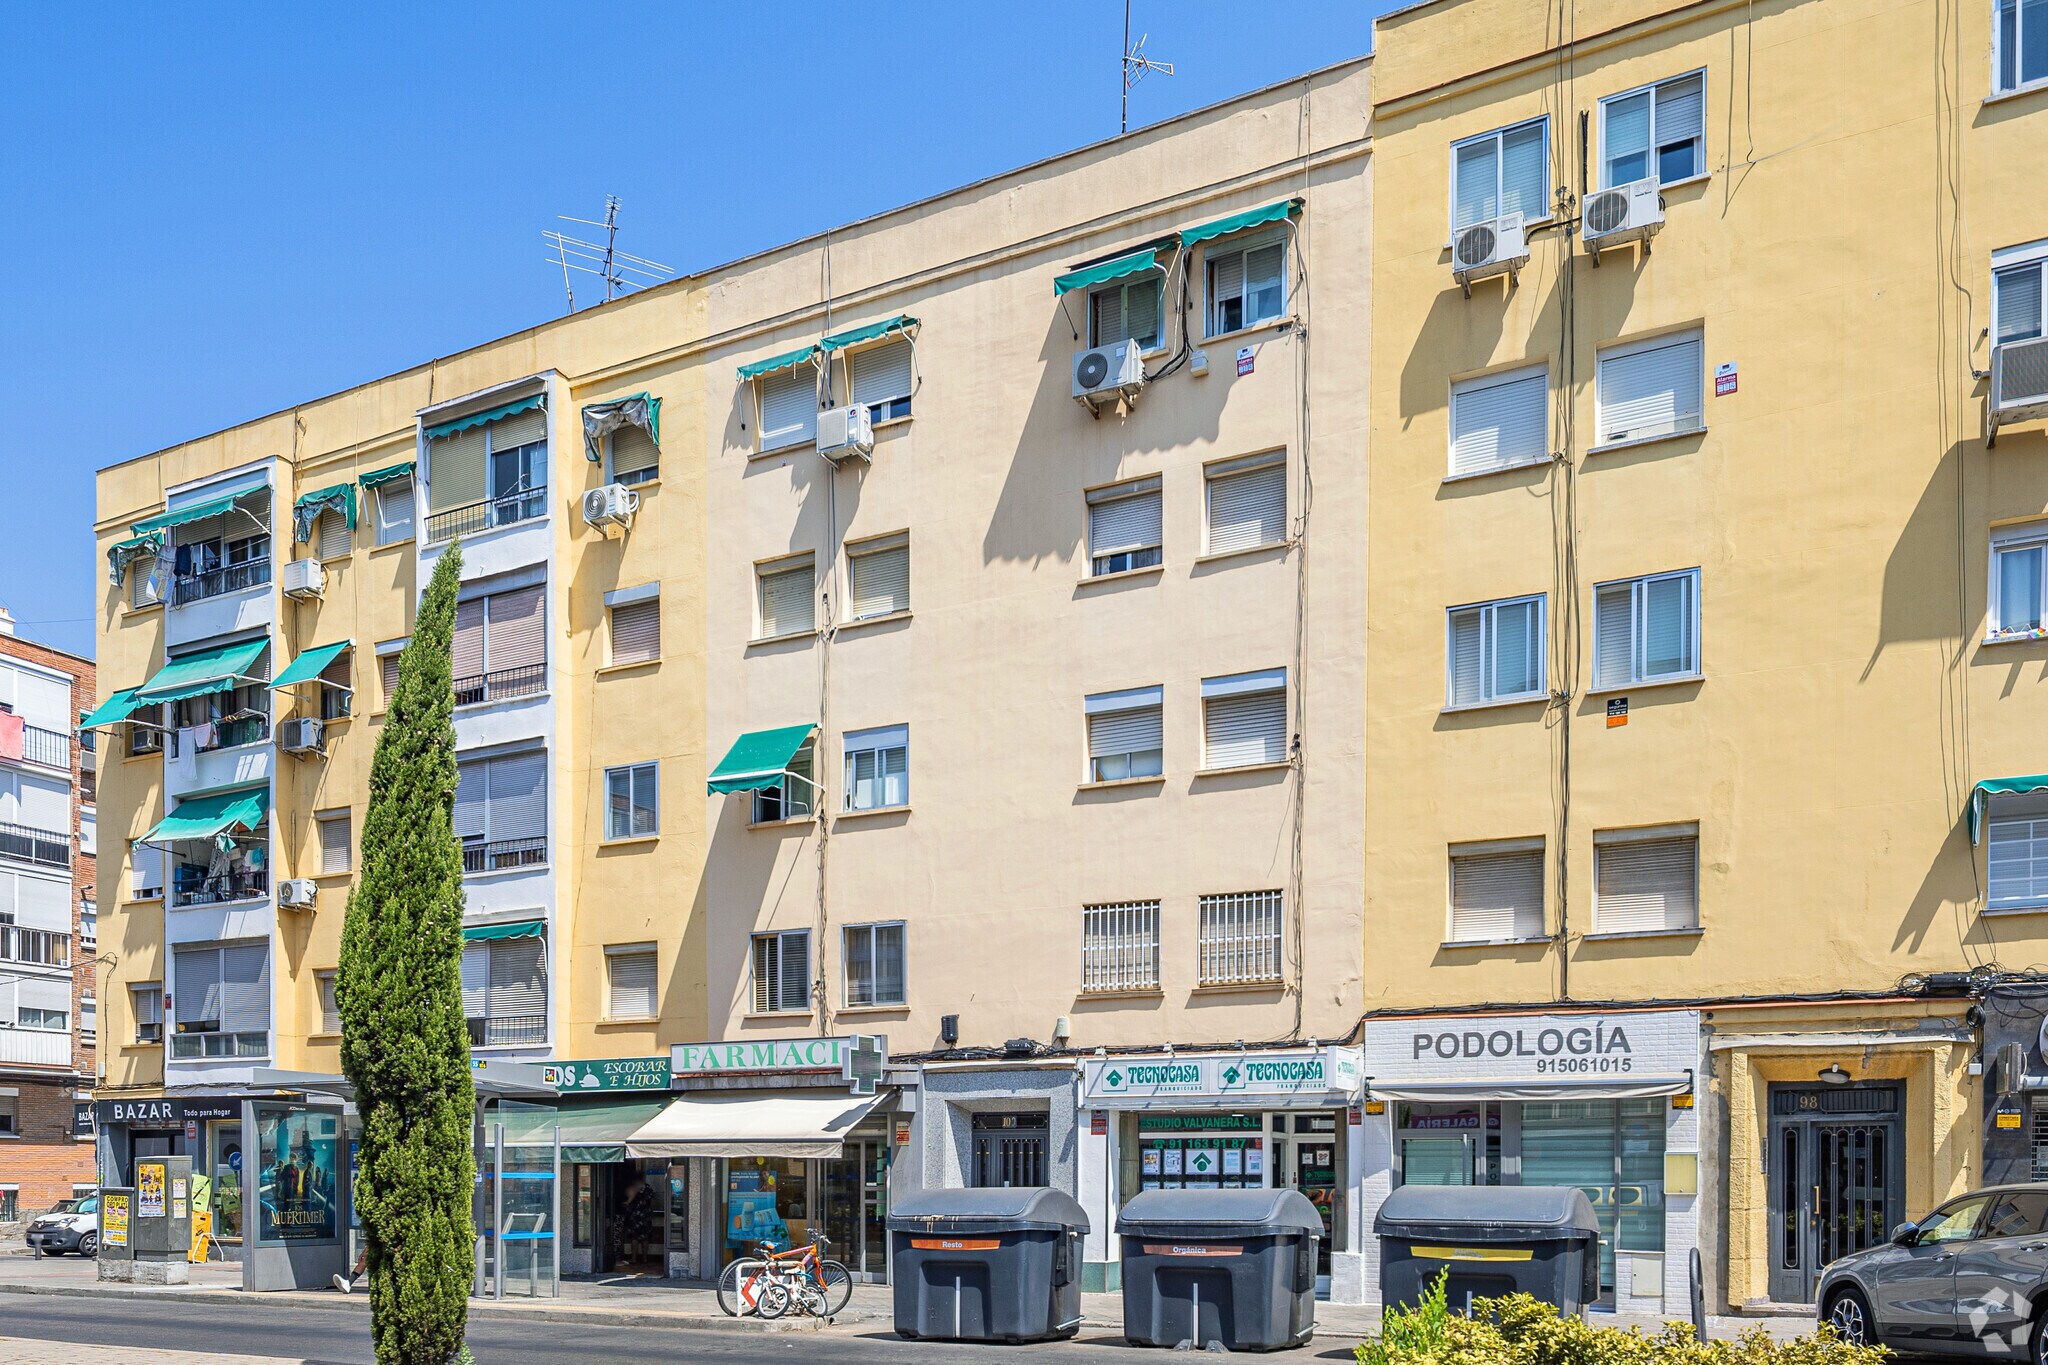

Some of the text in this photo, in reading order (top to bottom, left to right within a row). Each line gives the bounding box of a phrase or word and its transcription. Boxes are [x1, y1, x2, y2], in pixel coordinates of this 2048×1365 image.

[1413, 1021, 1631, 1059] PODOLOGÍA
[683, 1041, 840, 1068] FARMACI
[604, 1061, 667, 1074] ESCOBAR
[1246, 1062, 1323, 1082] TECNOCASA
[1537, 1057, 1631, 1073] 915061015
[609, 1073, 662, 1087] E HIJOS
[1128, 1064, 1199, 1084] TECNOCASA
[1800, 1096, 1817, 1109] 98
[114, 1103, 172, 1119] BAZAR
[200, 1110, 212, 1118] para
[213, 1108, 231, 1117] Hogar
[1140, 1117, 1261, 1129] ESTUDIO VALVANERA S.L.
[1169, 1138, 1247, 1149] 91 163 91 87
[271, 1209, 325, 1226] MUÉRTIMER
[942, 1241, 962, 1249] Resto
[1172, 1246, 1207, 1254] Orgánica
